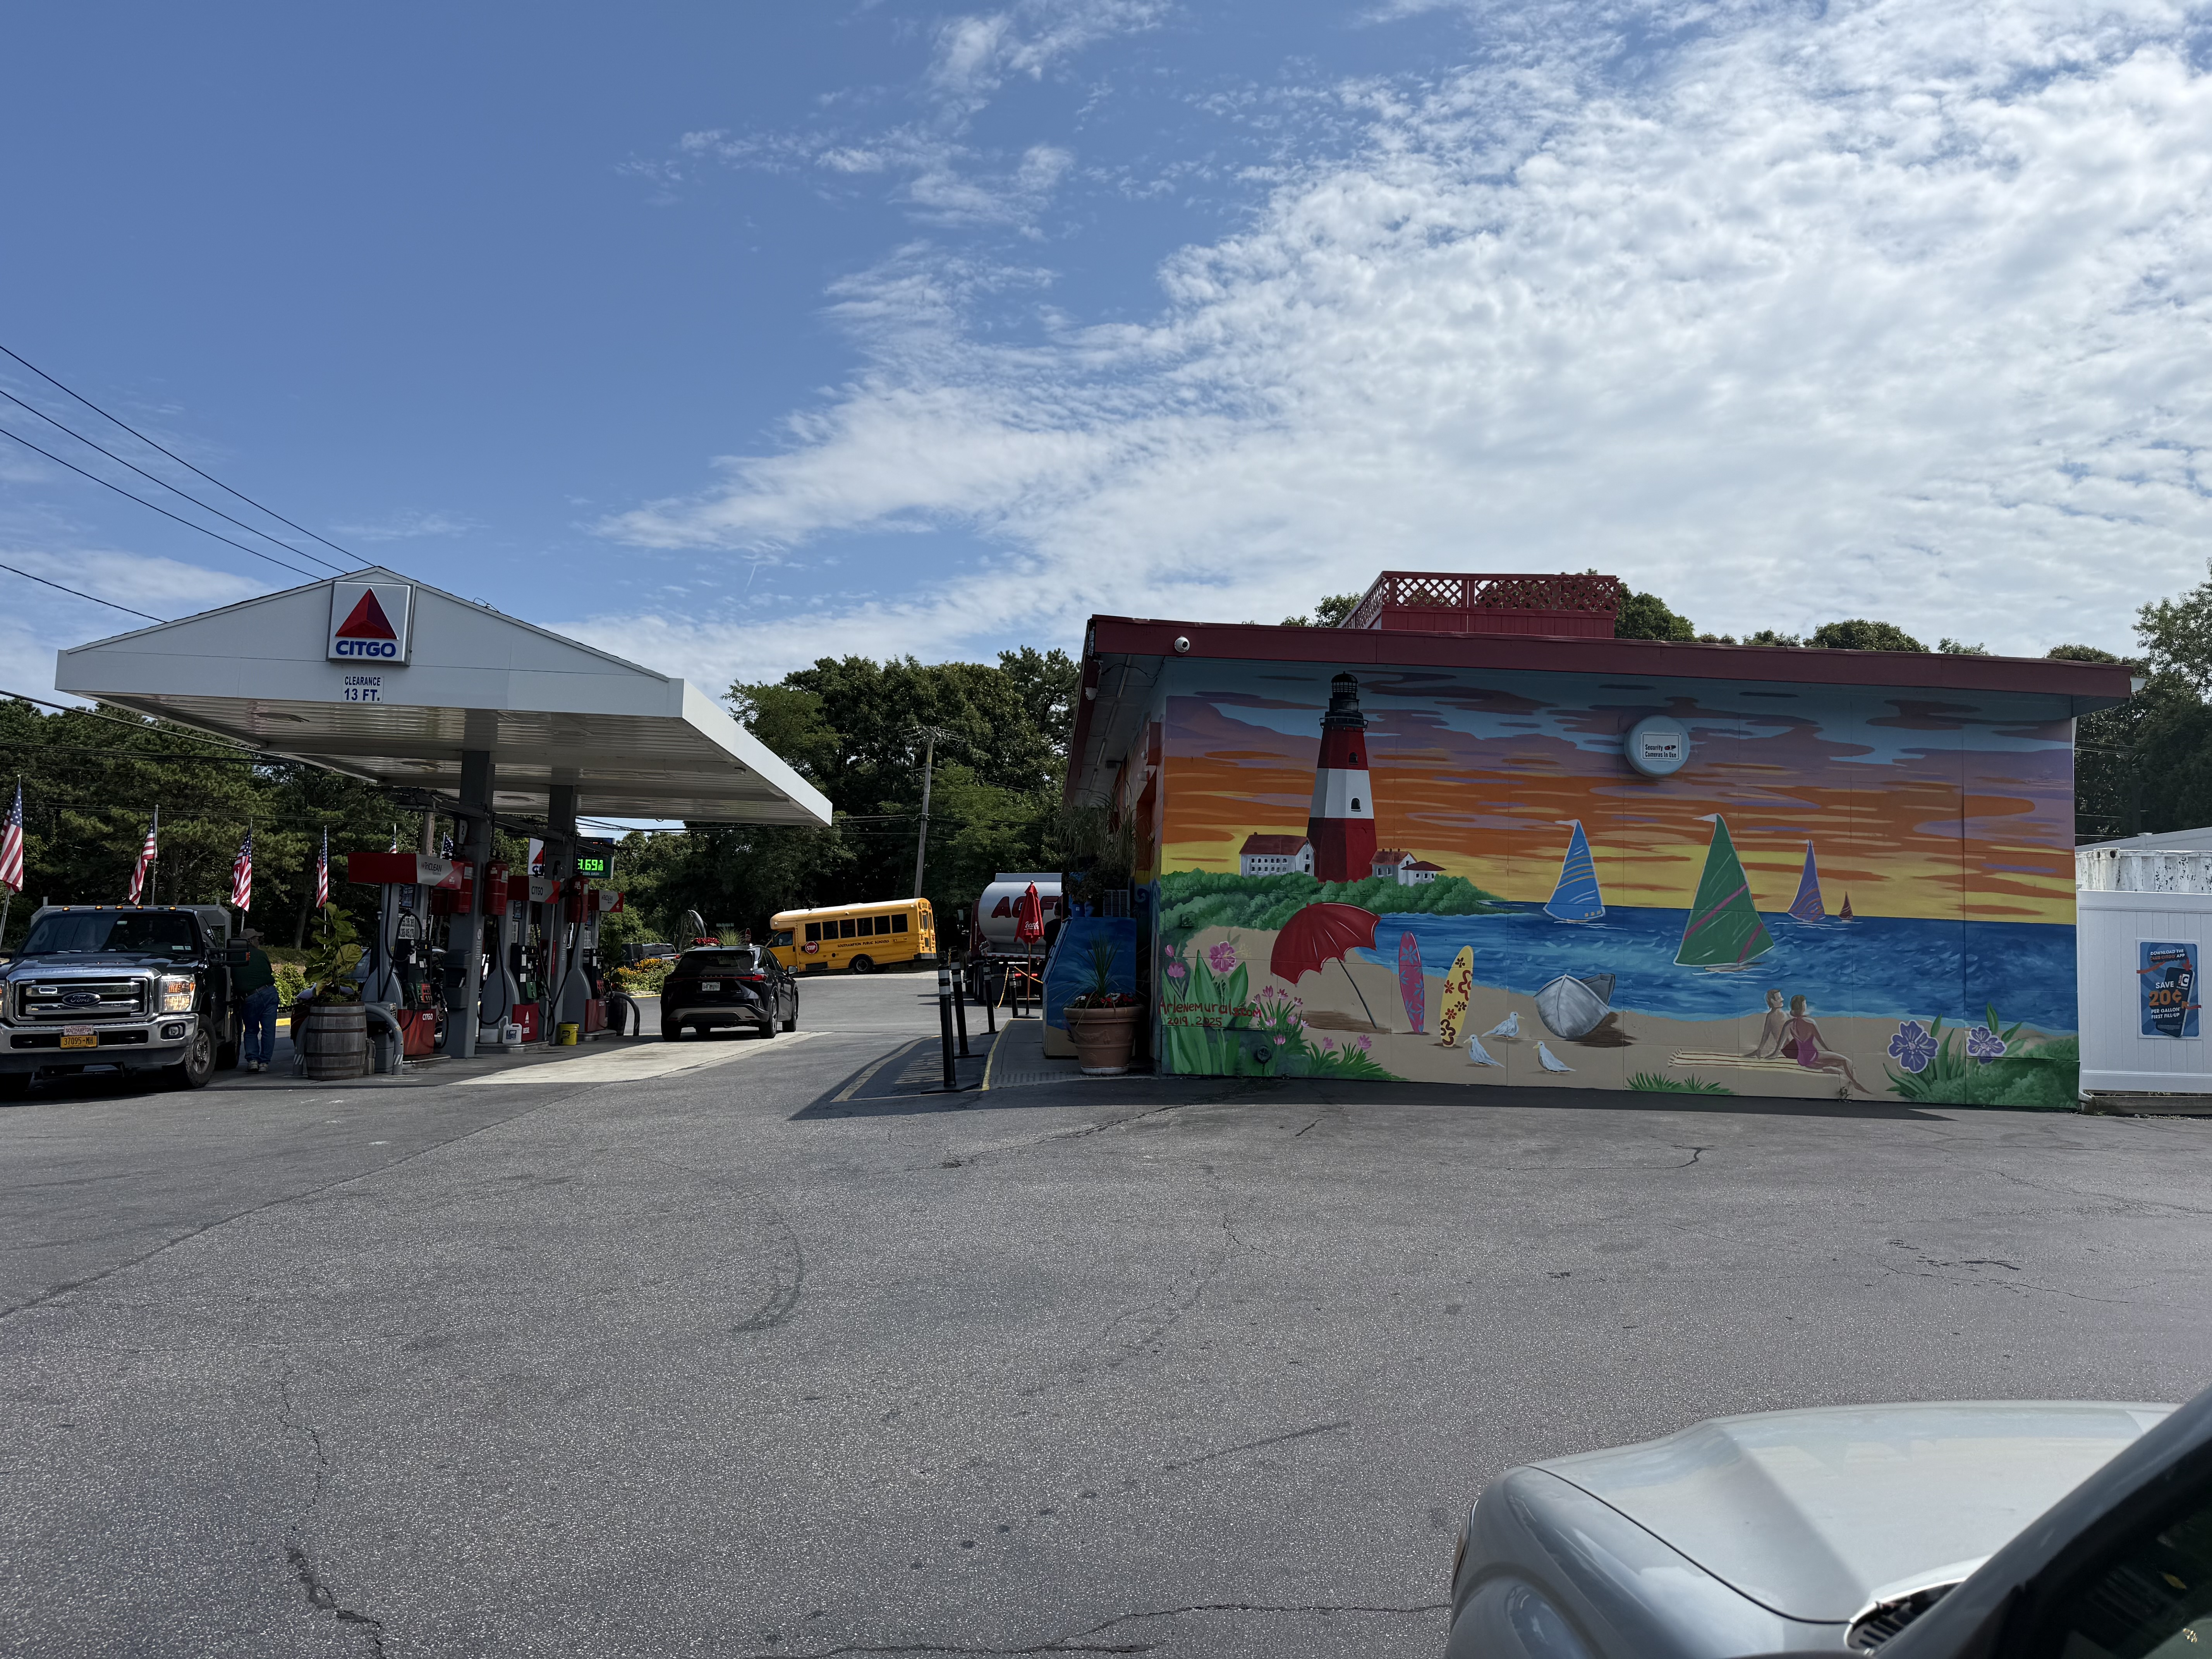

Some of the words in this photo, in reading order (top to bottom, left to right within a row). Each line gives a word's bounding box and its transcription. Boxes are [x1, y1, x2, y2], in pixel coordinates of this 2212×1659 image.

[336, 640, 396, 657] CITGO
[345, 676, 381, 686] CLEARANCE
[344, 688, 358, 701] 13
[362, 689, 380, 701] FT.
[462, 825, 464, 835] 2
[424, 862, 442, 872] TriCLEAN
[532, 886, 543, 895] CITGO
[2182, 976, 2189, 984] C
[70, 994, 91, 1003] Ford
[1167, 1016, 1188, 1026] 2019
